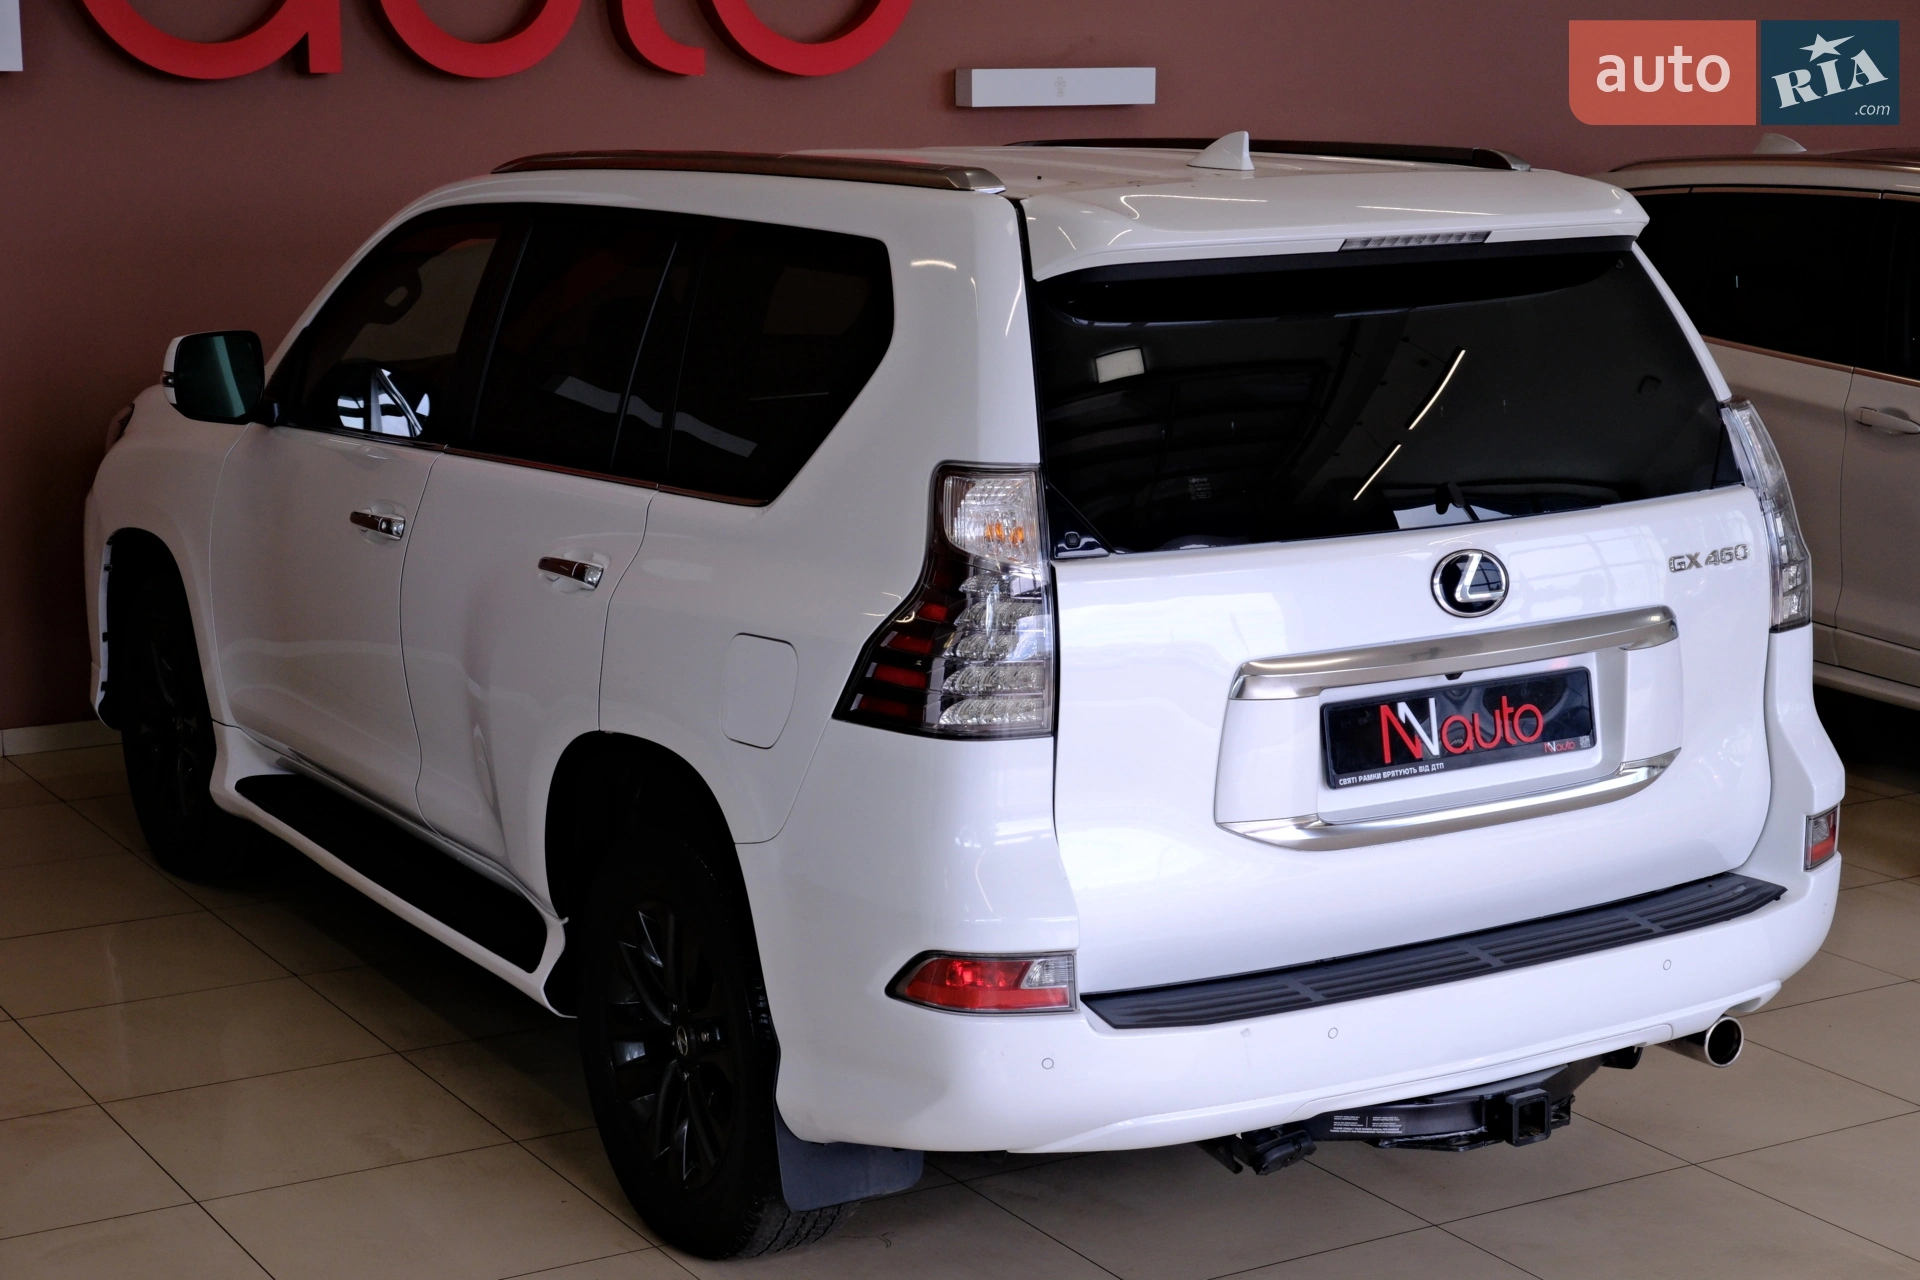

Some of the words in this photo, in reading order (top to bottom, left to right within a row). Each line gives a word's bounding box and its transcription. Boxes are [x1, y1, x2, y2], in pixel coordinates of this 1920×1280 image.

[1668, 552, 1703, 573] GX
[1704, 543, 1750, 567] 460
[1338, 778, 1358, 786] СВЯТІ
[1358, 772, 1382, 783] РАМКИ
[1382, 766, 1418, 779] ВРЯТУЮТЬ
[1418, 764, 1430, 773] ВІД
[1431, 762, 1445, 771] ДТП
